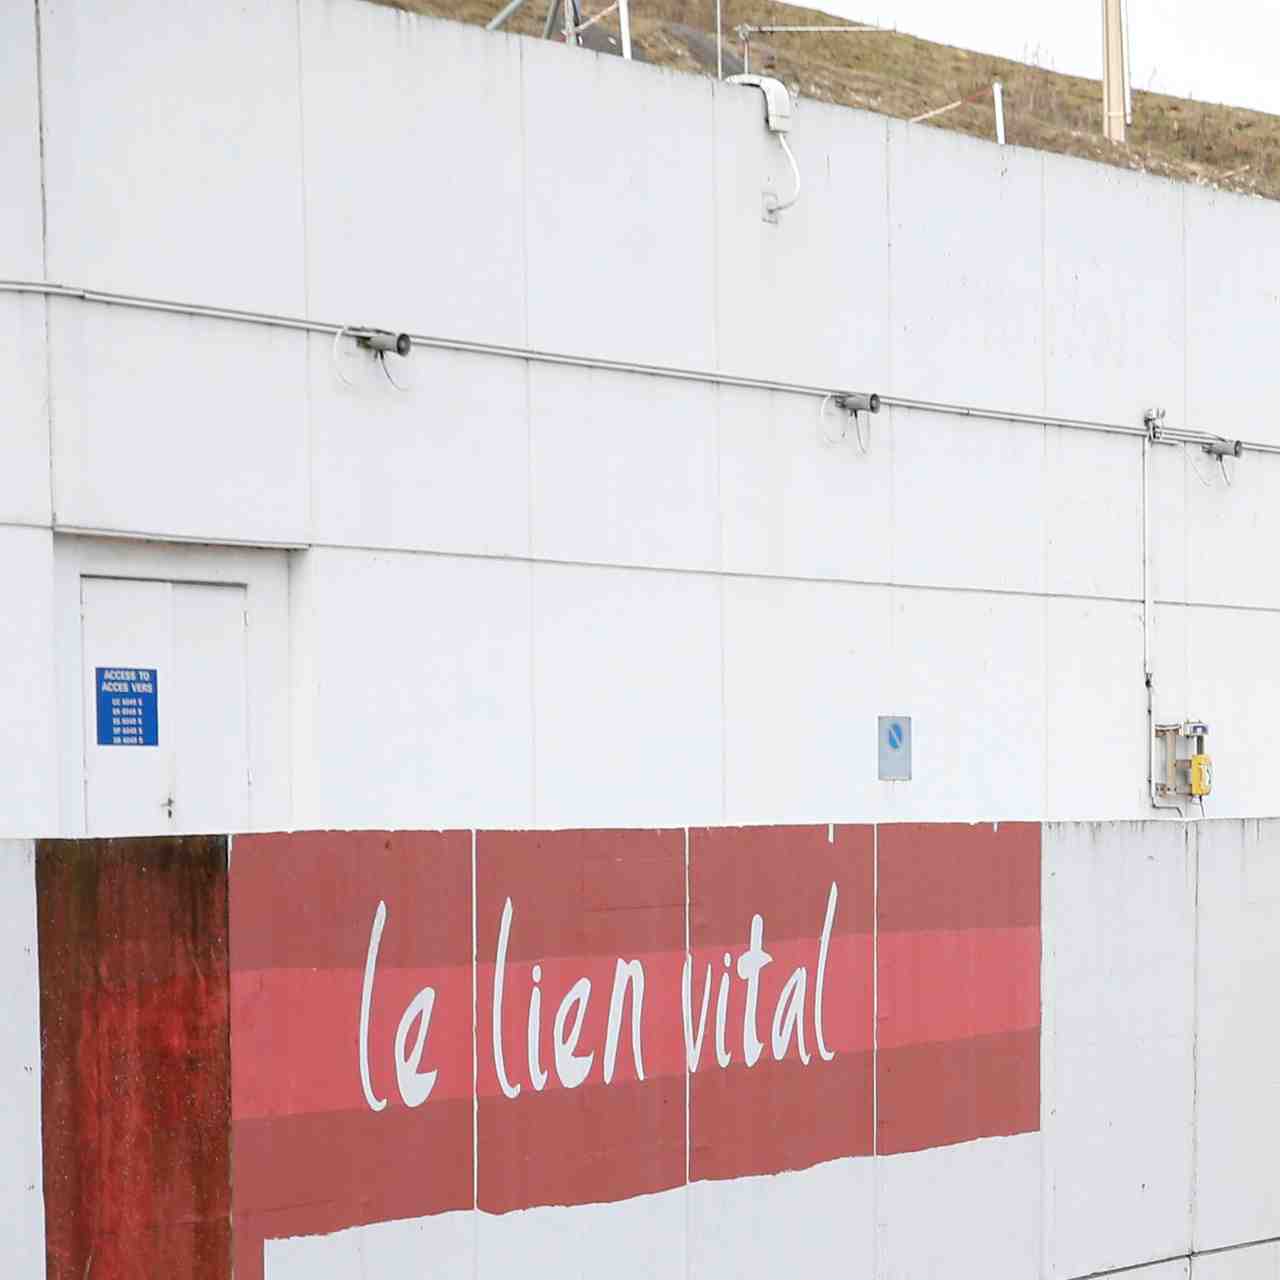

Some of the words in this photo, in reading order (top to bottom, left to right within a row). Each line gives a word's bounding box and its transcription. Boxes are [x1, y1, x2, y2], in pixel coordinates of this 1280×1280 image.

[359, 900, 437, 1112] le
[493, 896, 645, 1099] lien
[681, 880, 838, 1073] vital
